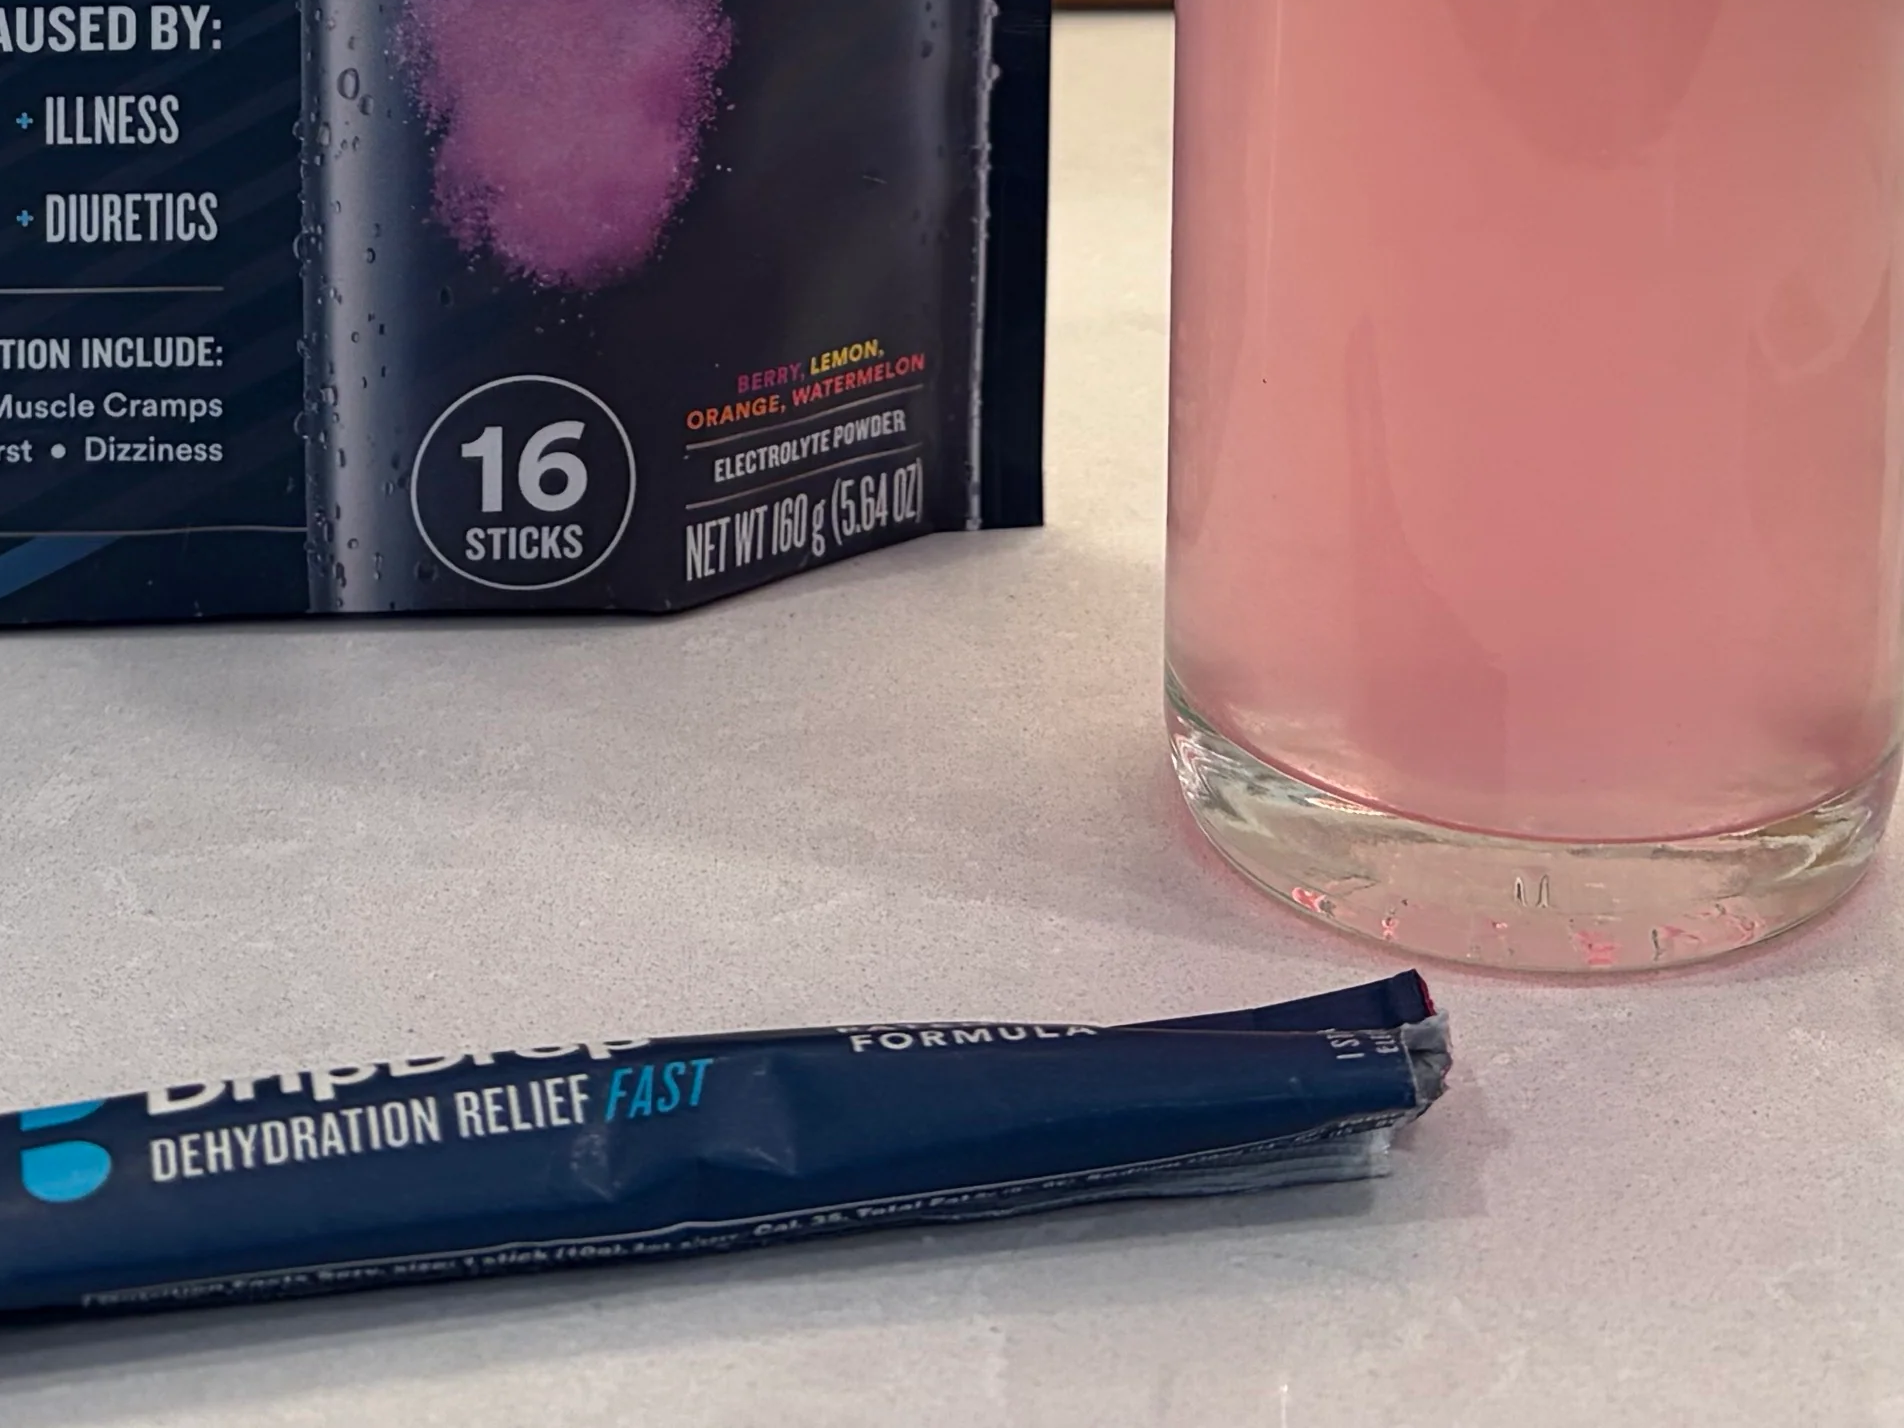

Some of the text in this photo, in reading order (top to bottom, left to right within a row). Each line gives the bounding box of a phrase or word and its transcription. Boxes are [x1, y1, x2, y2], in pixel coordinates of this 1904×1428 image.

[150, 4, 222, 50] BY:
[45, 94, 179, 145] ILLNESS
[45, 191, 218, 244] DIURETICS
[81, 336, 223, 368] INCLUDE:
[737, 339, 885, 394] BERRY, LEMON,
[103, 392, 223, 422] Cramps
[686, 352, 925, 430] ORANGE, WATERMELON
[84, 437, 223, 463] Dizziness
[461, 420, 588, 513] 16
[714, 409, 906, 483] ELECTROLYTE POWDER
[465, 524, 583, 561] STICKS
[686, 518, 730, 581] NET
[734, 504, 772, 569] WT
[772, 492, 808, 556] 160
[832, 476, 888, 546] (5.64
[894, 460, 923, 524] OZ)
[849, 1025, 1098, 1053] FORMULA
[150, 1058, 714, 1183] DEHYDRATION RELIEF FAST
